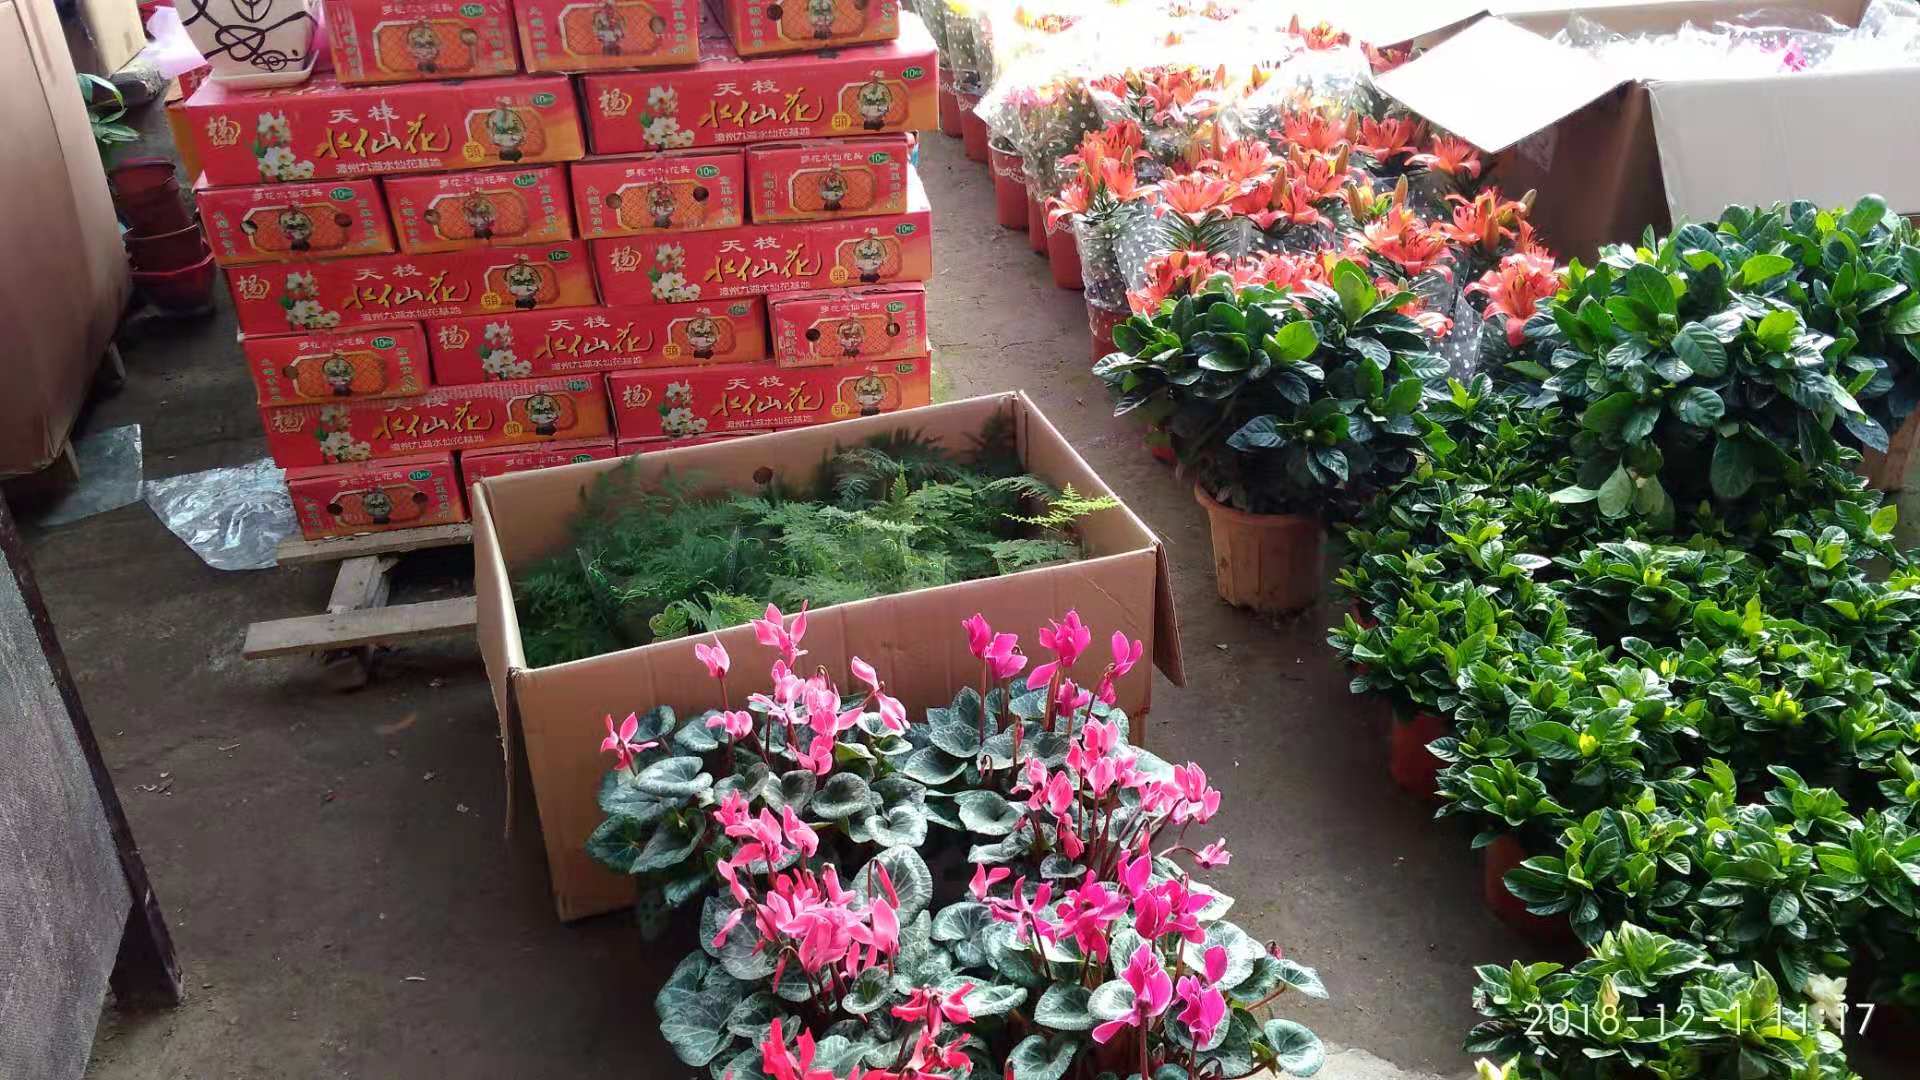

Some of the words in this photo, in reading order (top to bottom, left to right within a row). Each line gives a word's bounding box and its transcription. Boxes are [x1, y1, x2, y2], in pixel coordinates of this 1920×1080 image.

[699, 87, 824, 129] 水仙花
[315, 114, 453, 159] 水仙花
[704, 243, 822, 285] 水仙花
[344, 270, 472, 310] 水仙花
[534, 322, 654, 360] 水仙花
[710, 381, 825, 418] 水仙花
[376, 401, 494, 440] 水仙花
